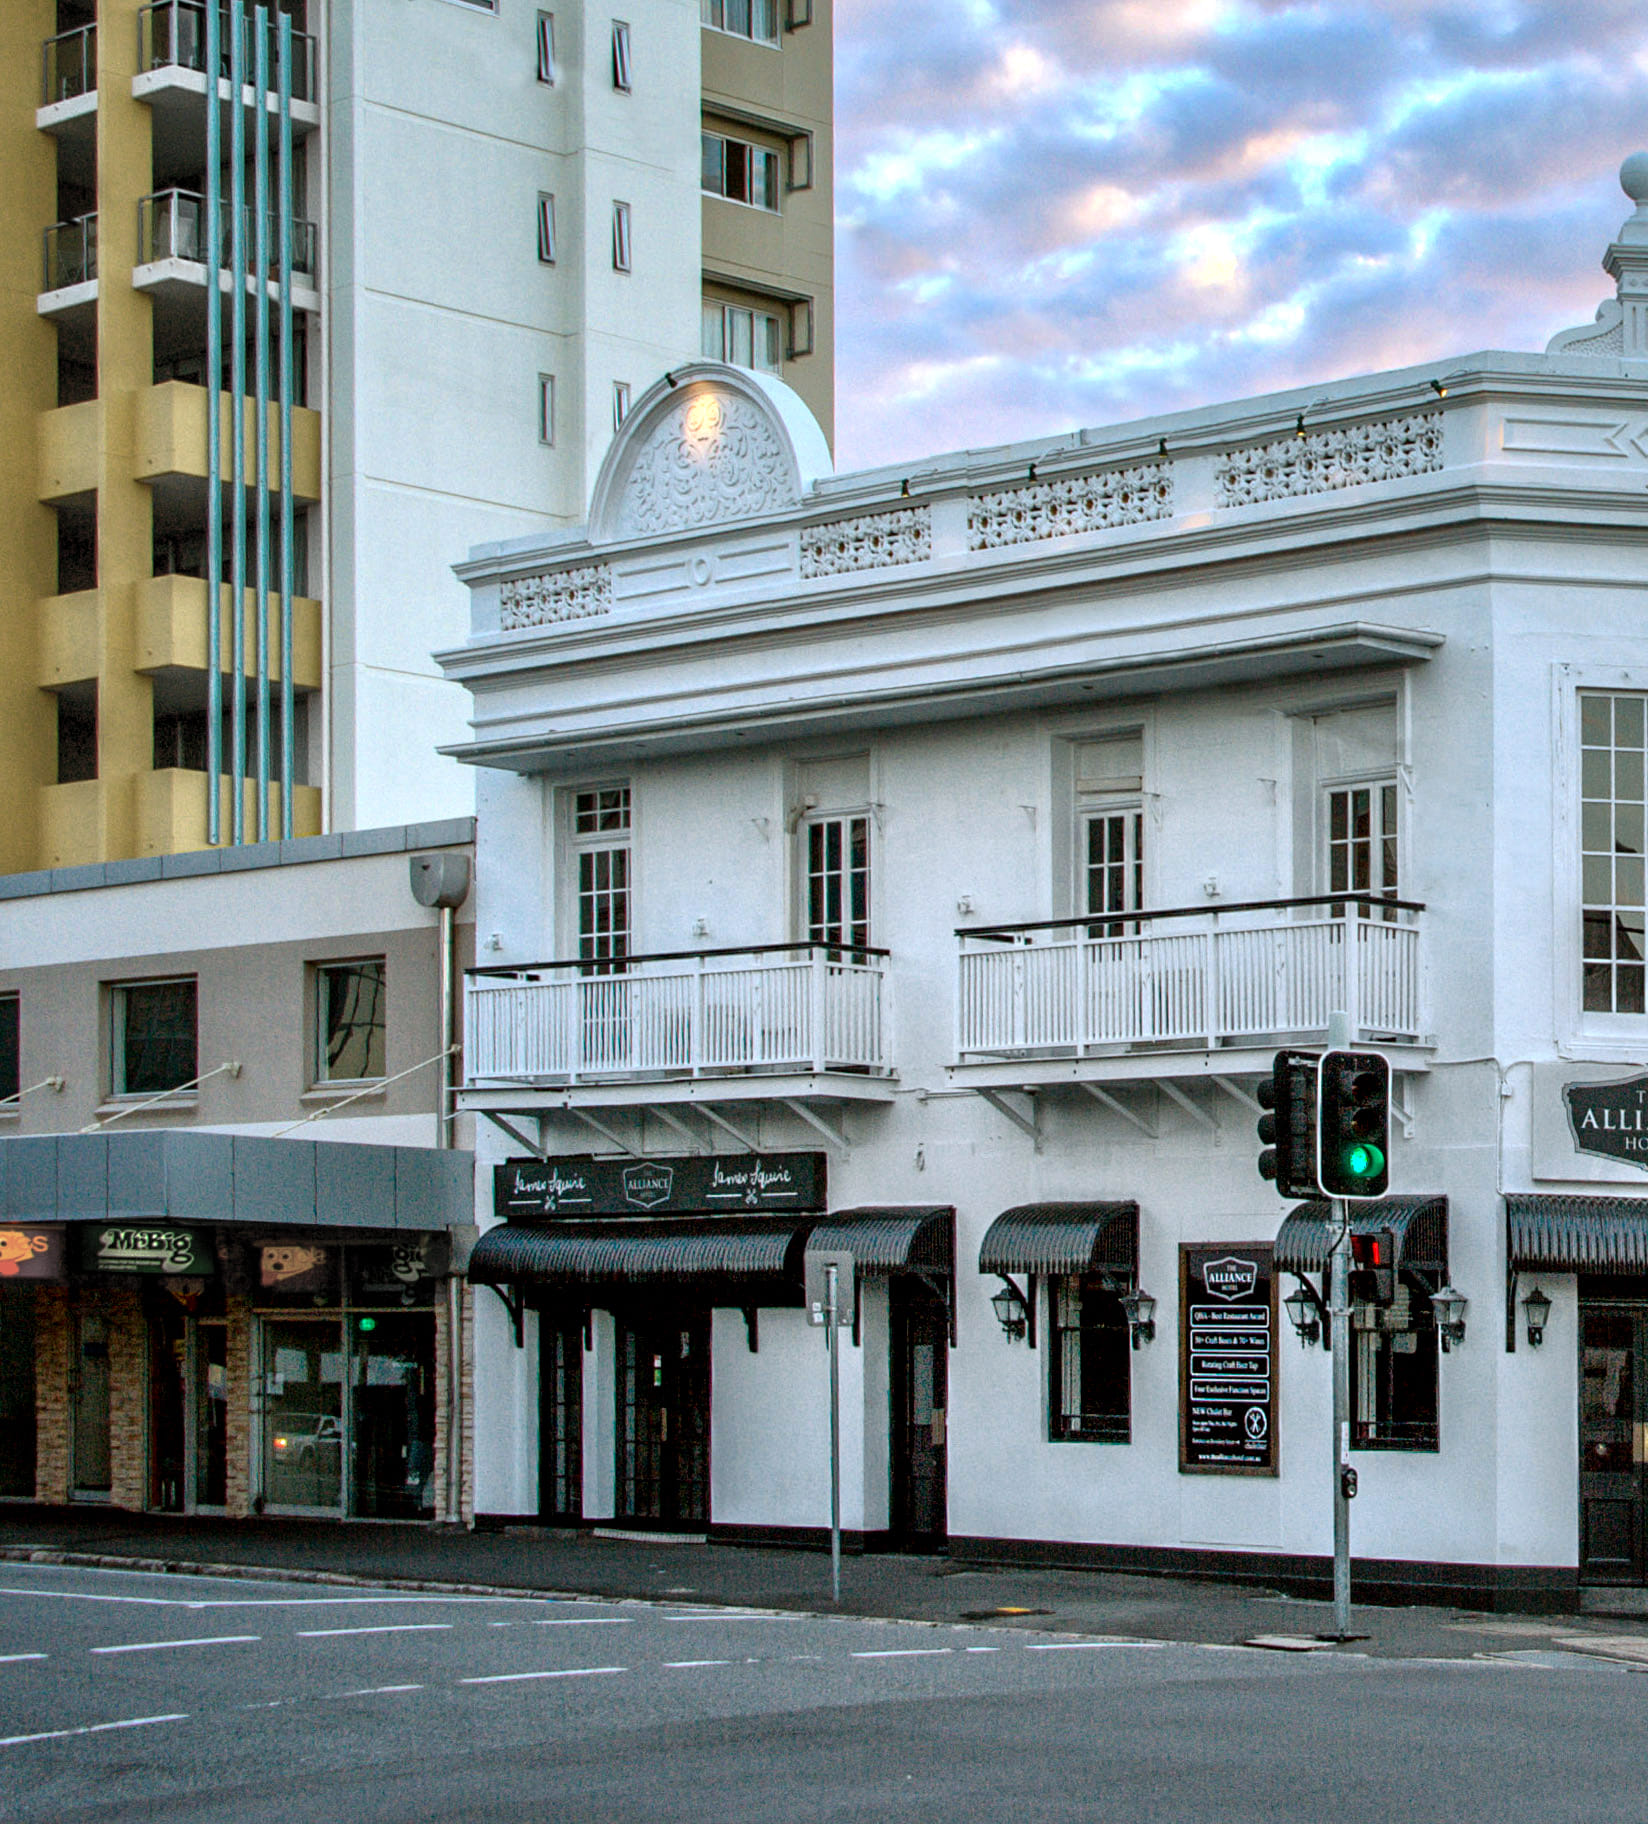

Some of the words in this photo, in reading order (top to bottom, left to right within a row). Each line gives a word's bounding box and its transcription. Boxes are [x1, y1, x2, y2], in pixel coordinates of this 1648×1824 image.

[513, 1168, 547, 1195] James
[547, 1167, 587, 1197] Squire
[627, 1178, 669, 1190] ALLIANCE
[712, 1160, 748, 1188] James
[749, 1159, 792, 1189] Squire
[1209, 1272, 1253, 1283] ALLIANCE
